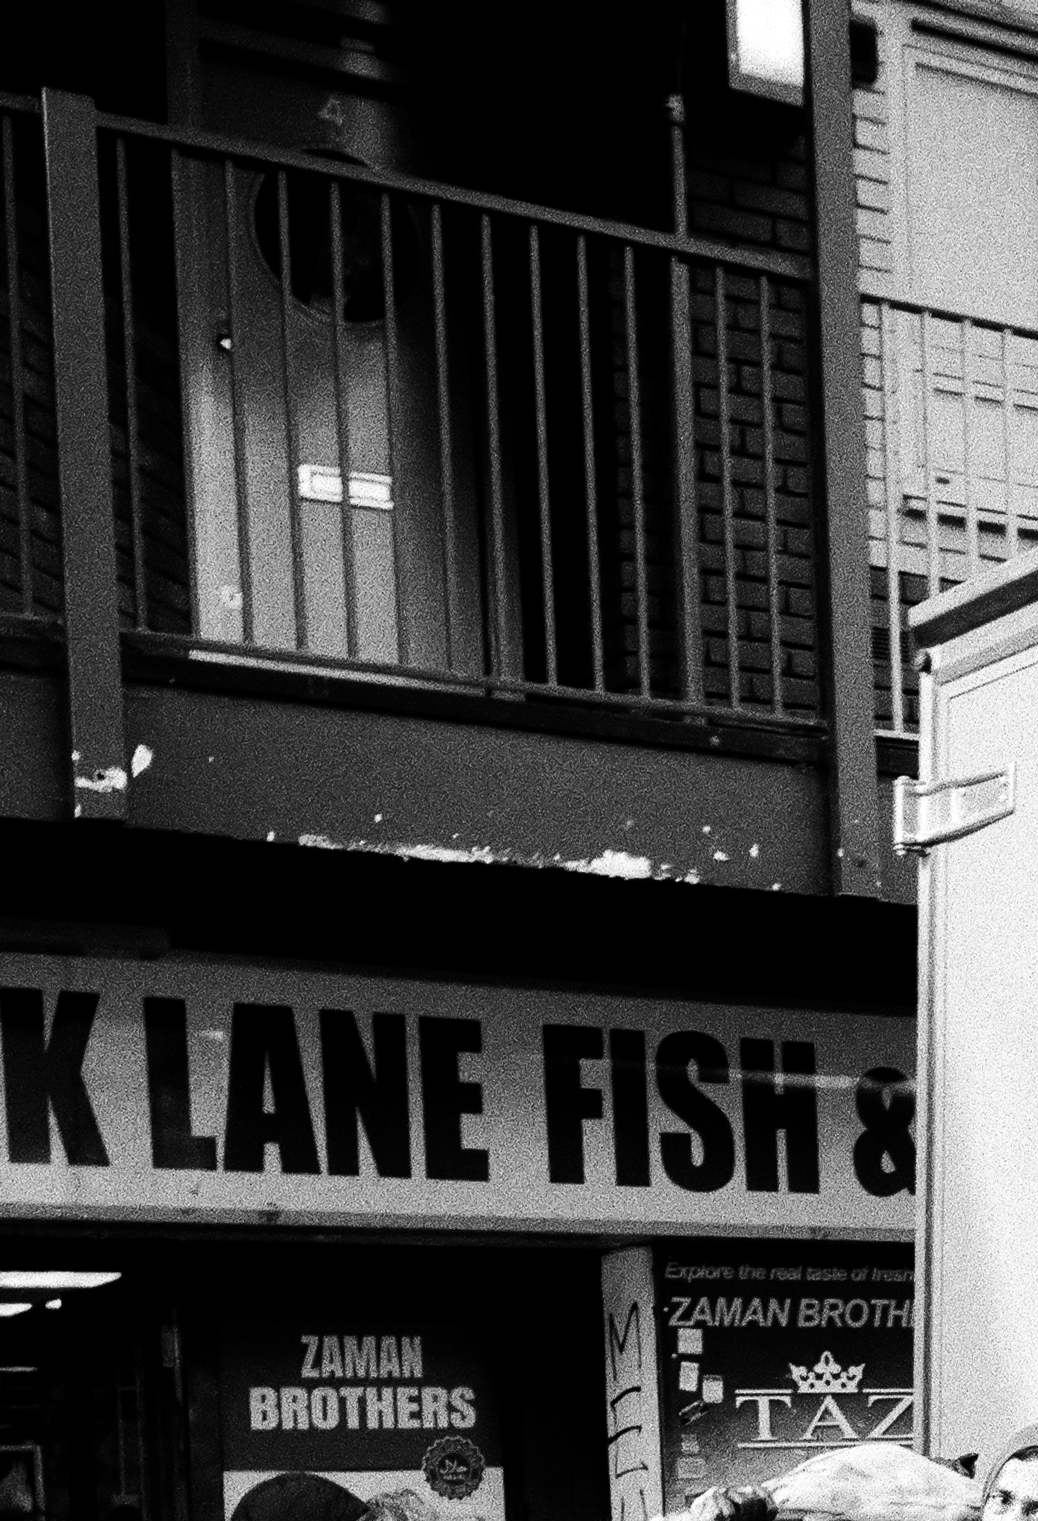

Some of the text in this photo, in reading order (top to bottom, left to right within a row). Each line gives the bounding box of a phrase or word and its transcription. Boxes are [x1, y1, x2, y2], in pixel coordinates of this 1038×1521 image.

[316, 96, 346, 127] 4
[0, 986, 916, 1198] K LANE FISH &
[664, 1262, 735, 1283] Explore
[738, 1264, 767, 1281] the
[770, 1265, 803, 1281] real
[806, 1265, 848, 1282] taste
[851, 1265, 870, 1282] of
[668, 1296, 914, 1328] ZAMAN BROTH
[300, 1334, 424, 1379] ZAMAN
[249, 1386, 477, 1431] BROTHERS
[735, 1395, 914, 1441] TAZ
